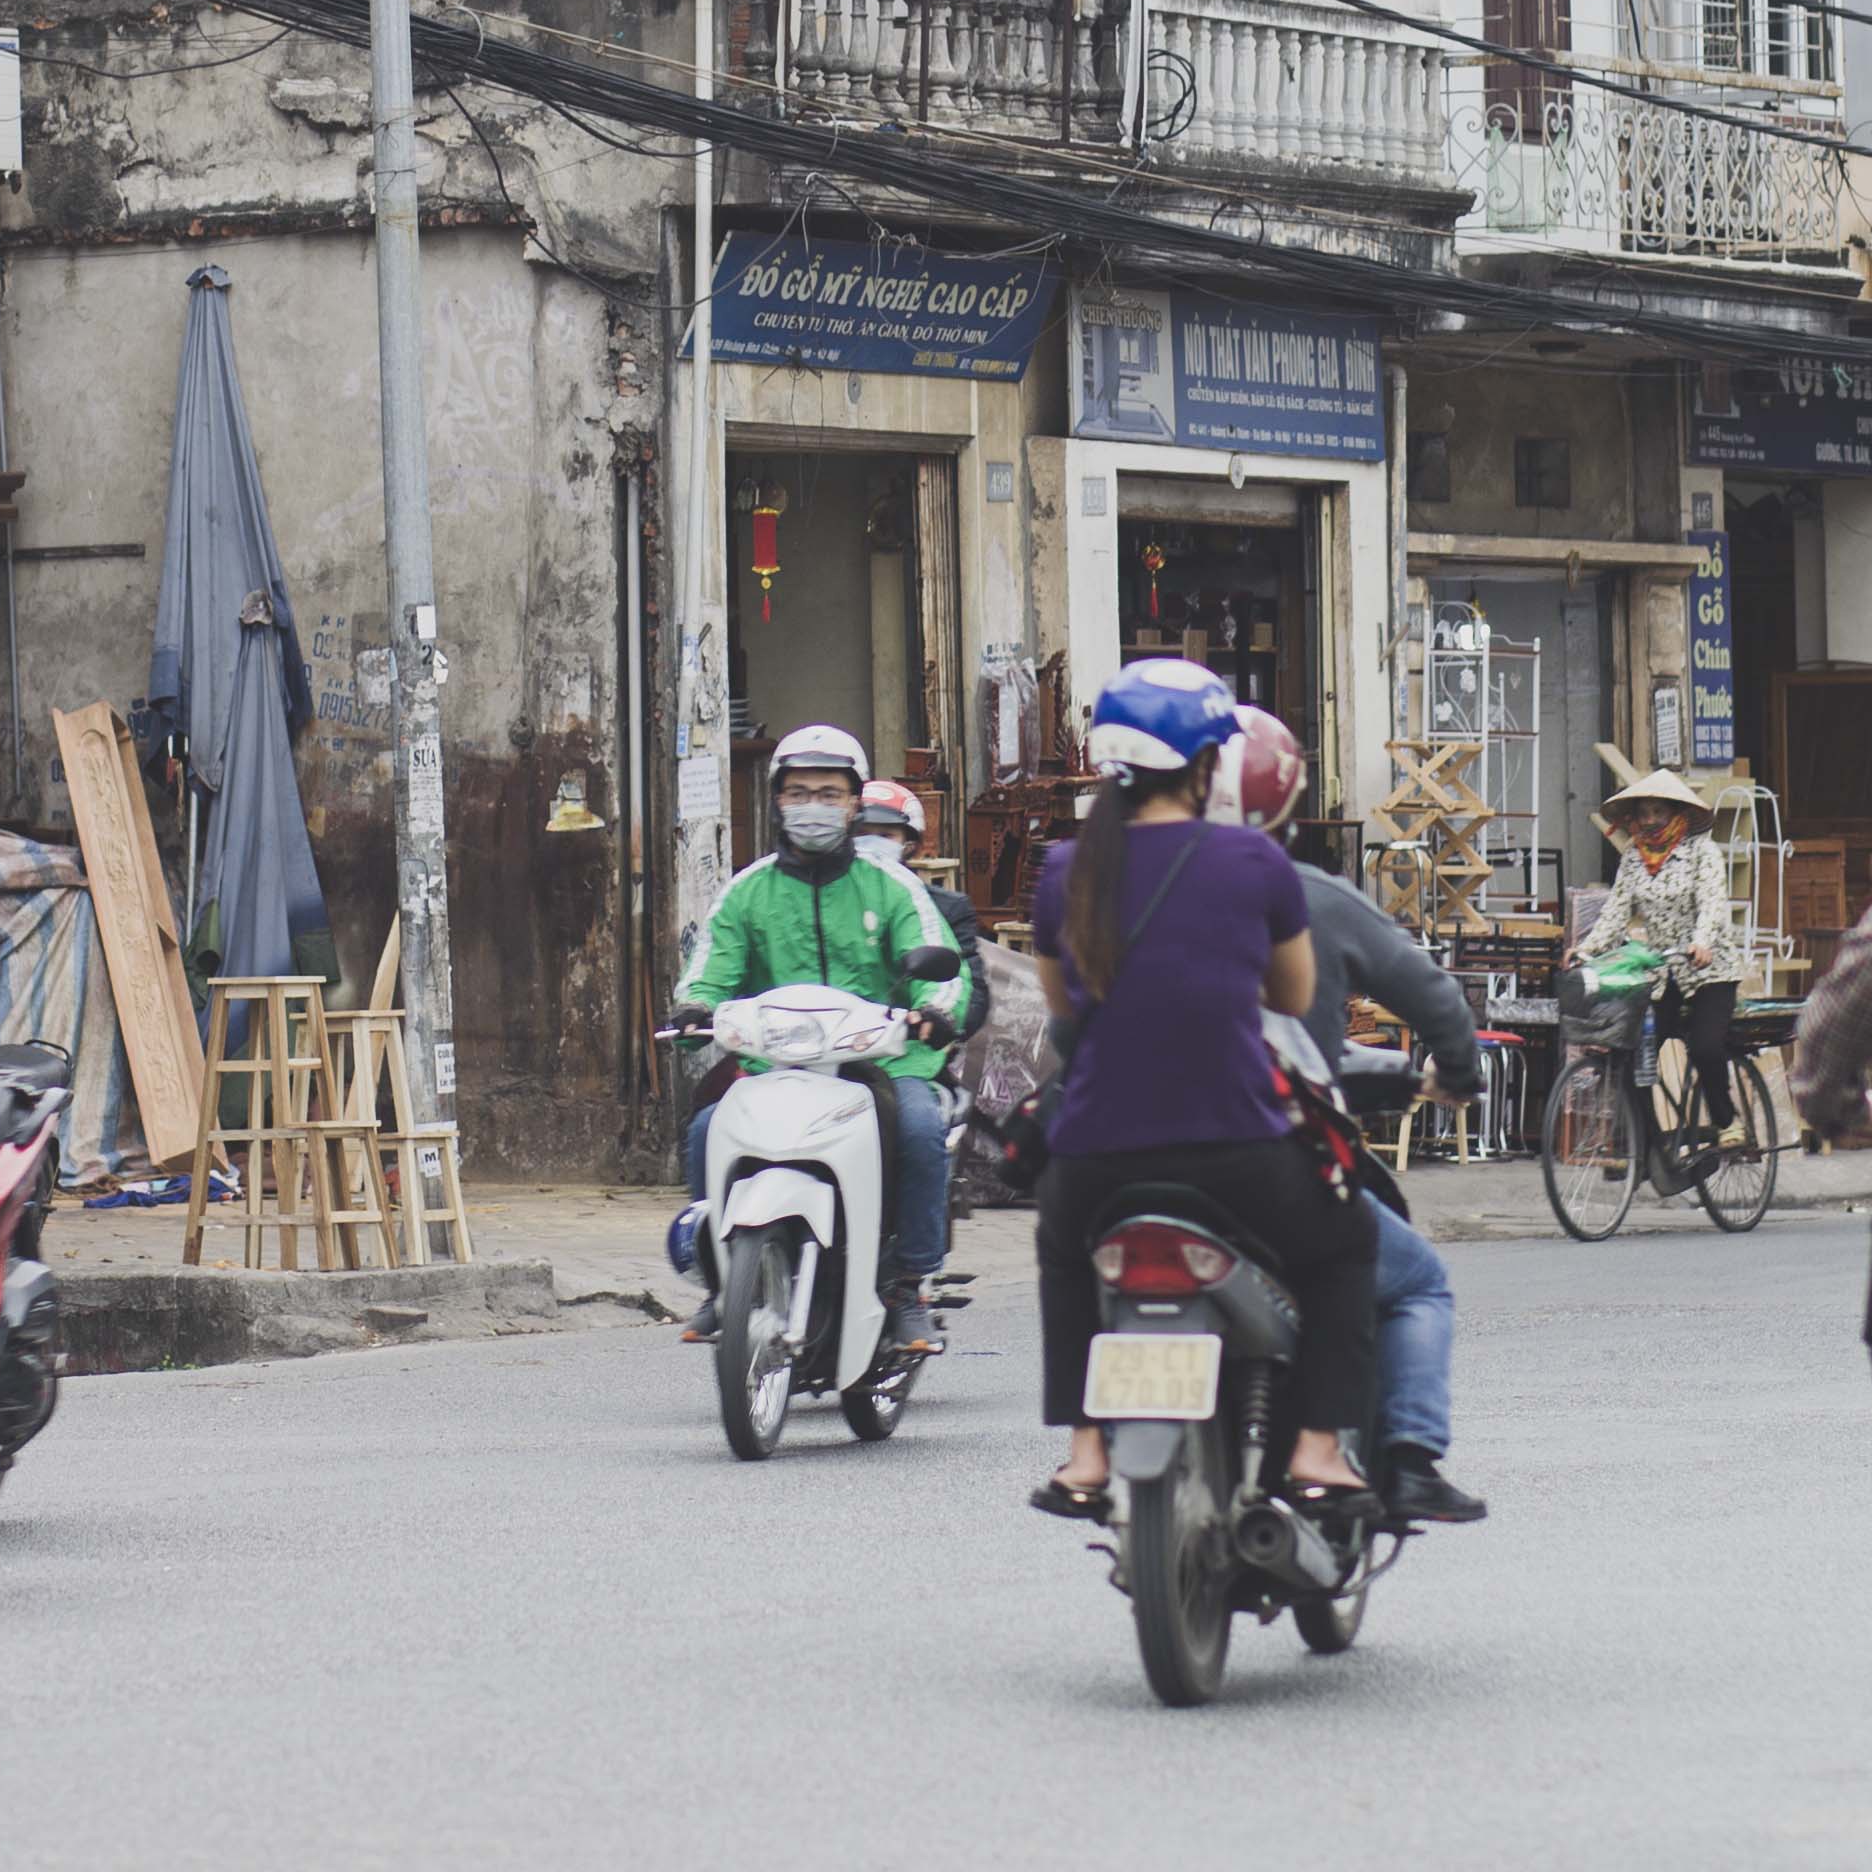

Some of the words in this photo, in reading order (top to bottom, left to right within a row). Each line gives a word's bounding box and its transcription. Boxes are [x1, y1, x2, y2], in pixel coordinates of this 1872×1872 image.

[739, 250, 788, 299] ĐỒ
[781, 254, 825, 303] GỖ
[817, 265, 863, 306] MỸ
[857, 271, 929, 320] NGHỆ
[928, 282, 978, 317] CAO
[979, 272, 1029, 320] CẤP
[1184, 312, 1208, 378] NỘI
[1210, 310, 1241, 380] THẤT
[1243, 318, 1271, 383] VĂN
[1317, 334, 1340, 390] GIA
[991, 471, 1011, 496] 439
[1698, 540, 1724, 578] Đồ
[1698, 587, 1724, 625] Gỗ
[1693, 638, 1730, 670] Chín
[1695, 685, 1733, 719] Phước
